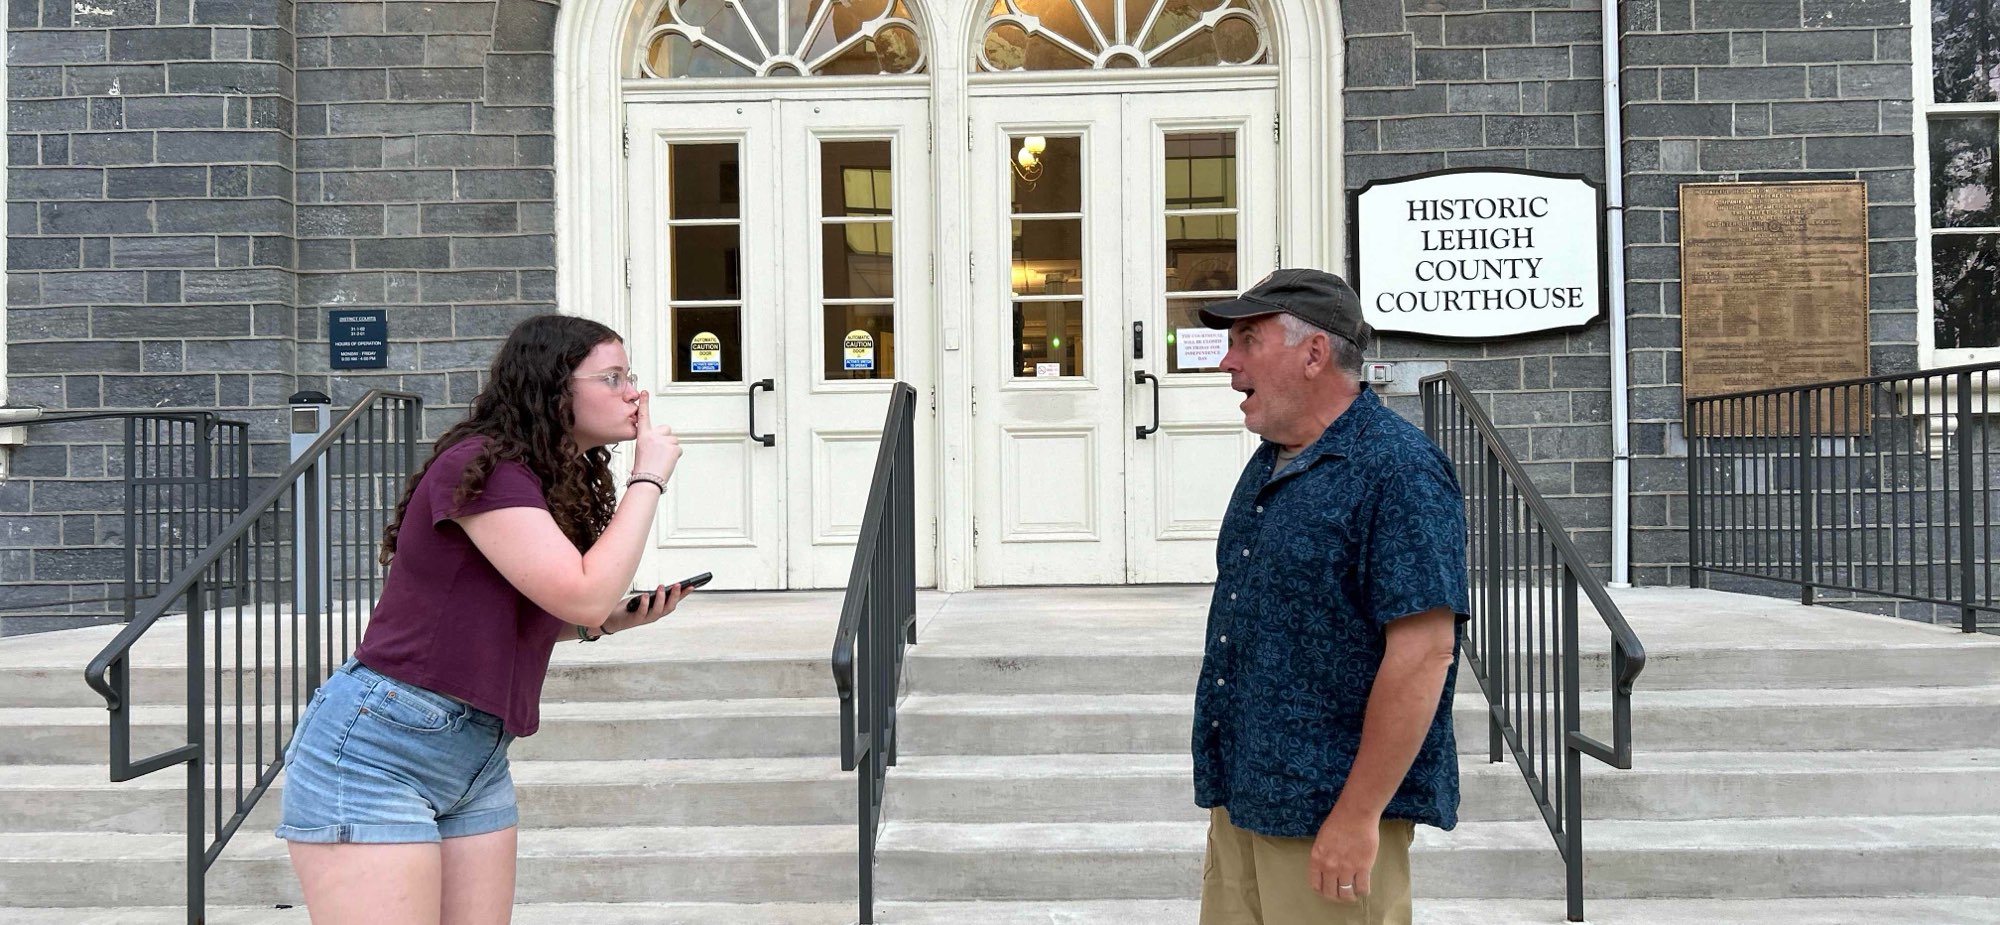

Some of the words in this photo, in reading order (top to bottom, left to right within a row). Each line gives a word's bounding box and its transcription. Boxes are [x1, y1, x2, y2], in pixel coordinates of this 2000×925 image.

[1407, 197, 1548, 221] HISTORIC
[1421, 227, 1535, 251] LEHIGH
[1415, 257, 1543, 282] COUNTY
[1376, 287, 1584, 313] COURTHOUSE
